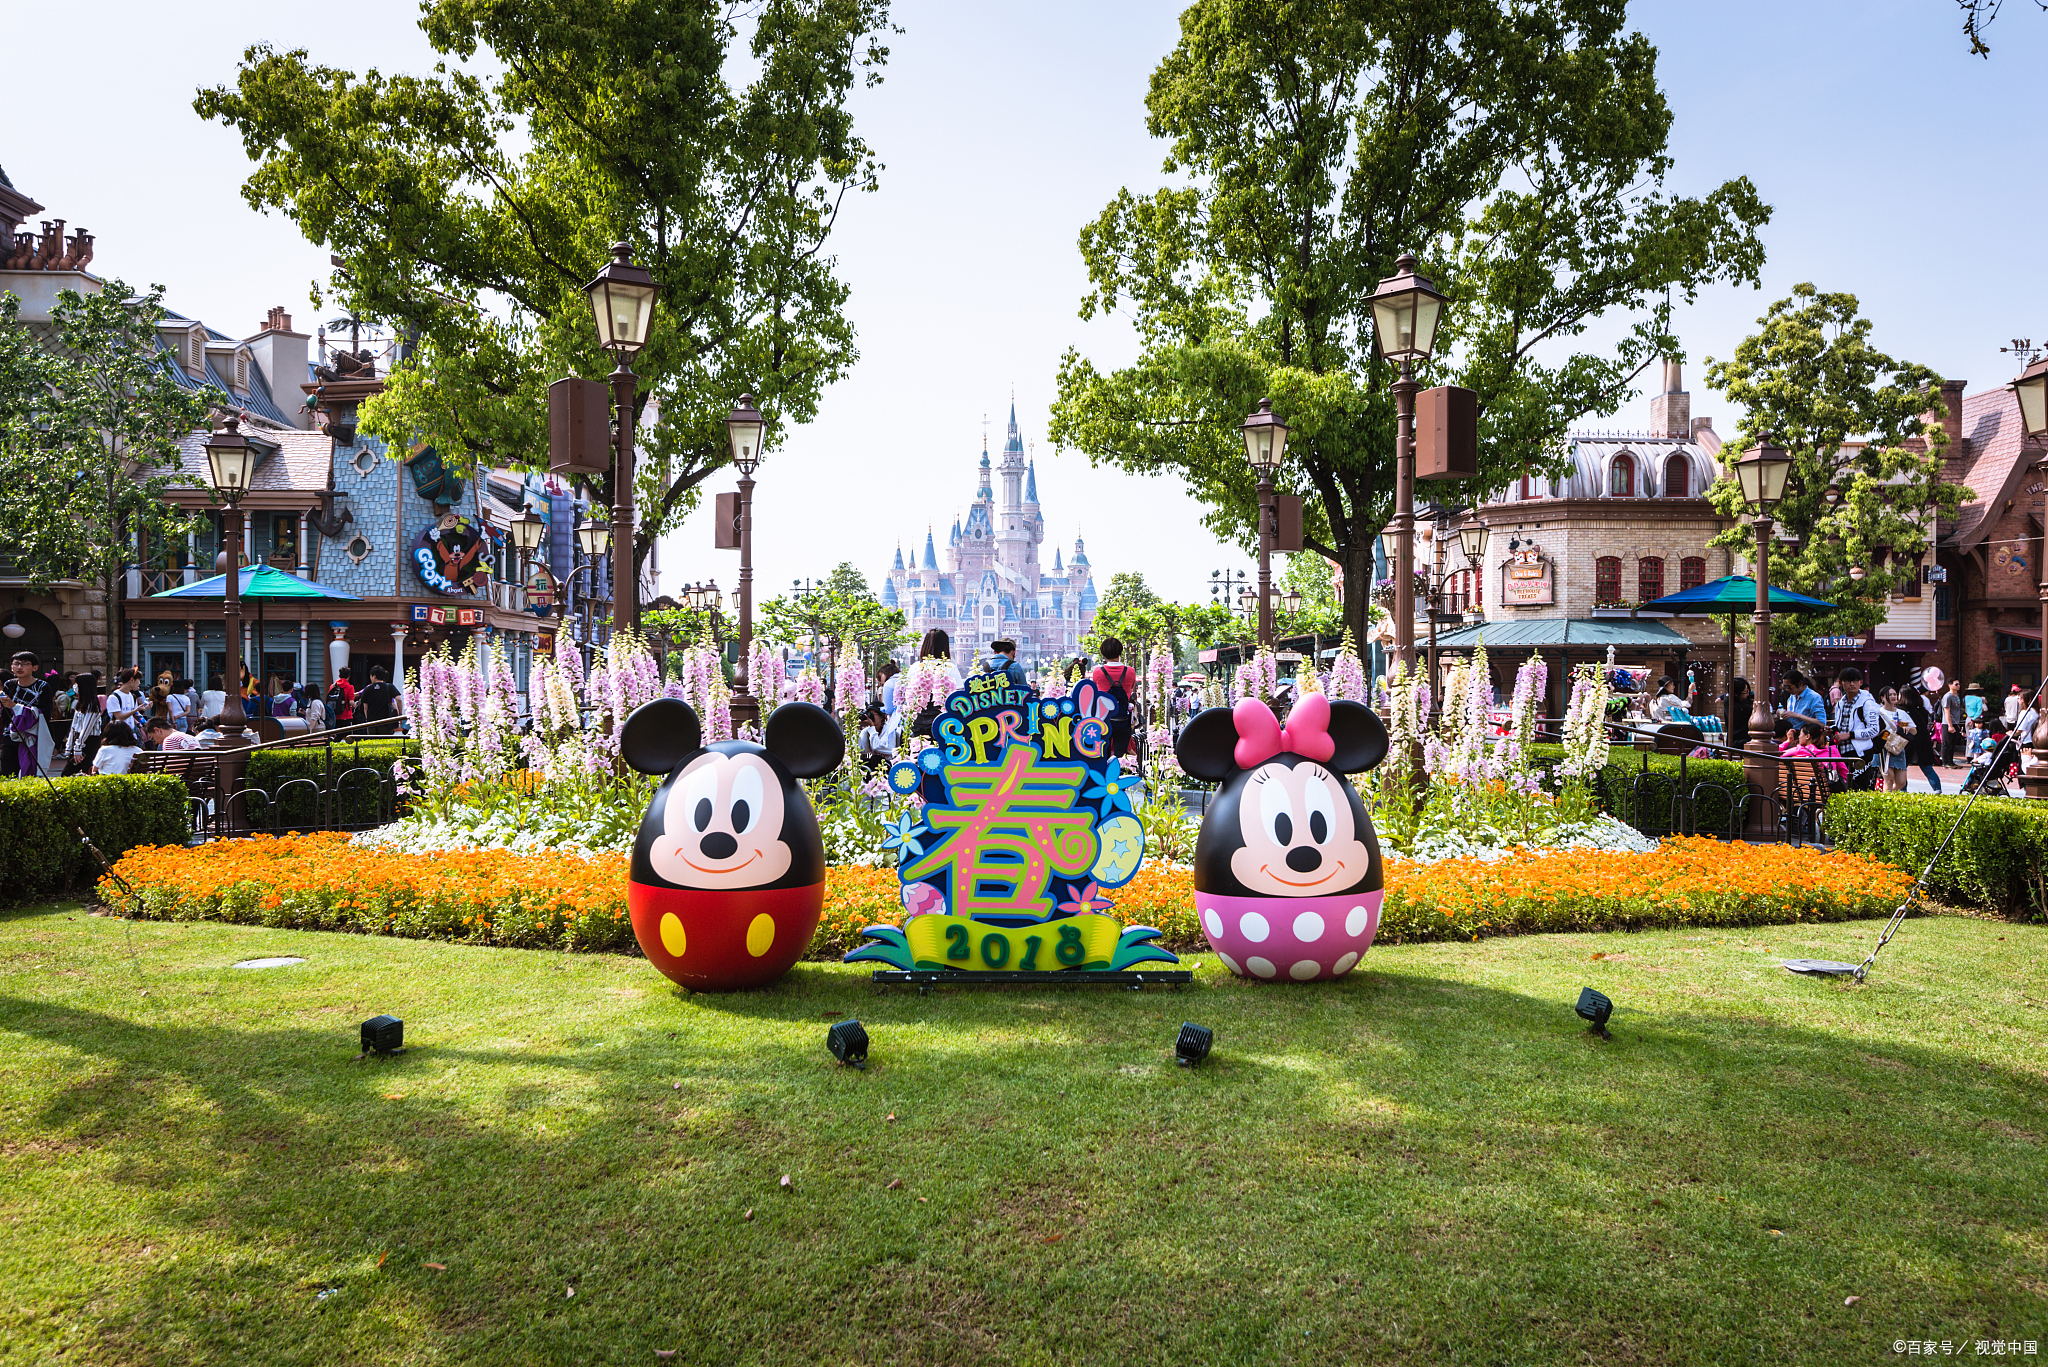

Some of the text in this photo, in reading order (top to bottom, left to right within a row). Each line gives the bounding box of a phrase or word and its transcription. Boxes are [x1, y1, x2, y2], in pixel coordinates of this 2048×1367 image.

[2025, 481, 2044, 495] THR
[415, 547, 452, 591] GOOFY
[535, 578, 548, 608] 玩具
[969, 672, 1010, 694] 迪士尼
[951, 687, 1030, 718] DISNEY
[939, 702, 1109, 765] SPRING
[904, 744, 1098, 920] 春
[945, 923, 1086, 971] 2018
